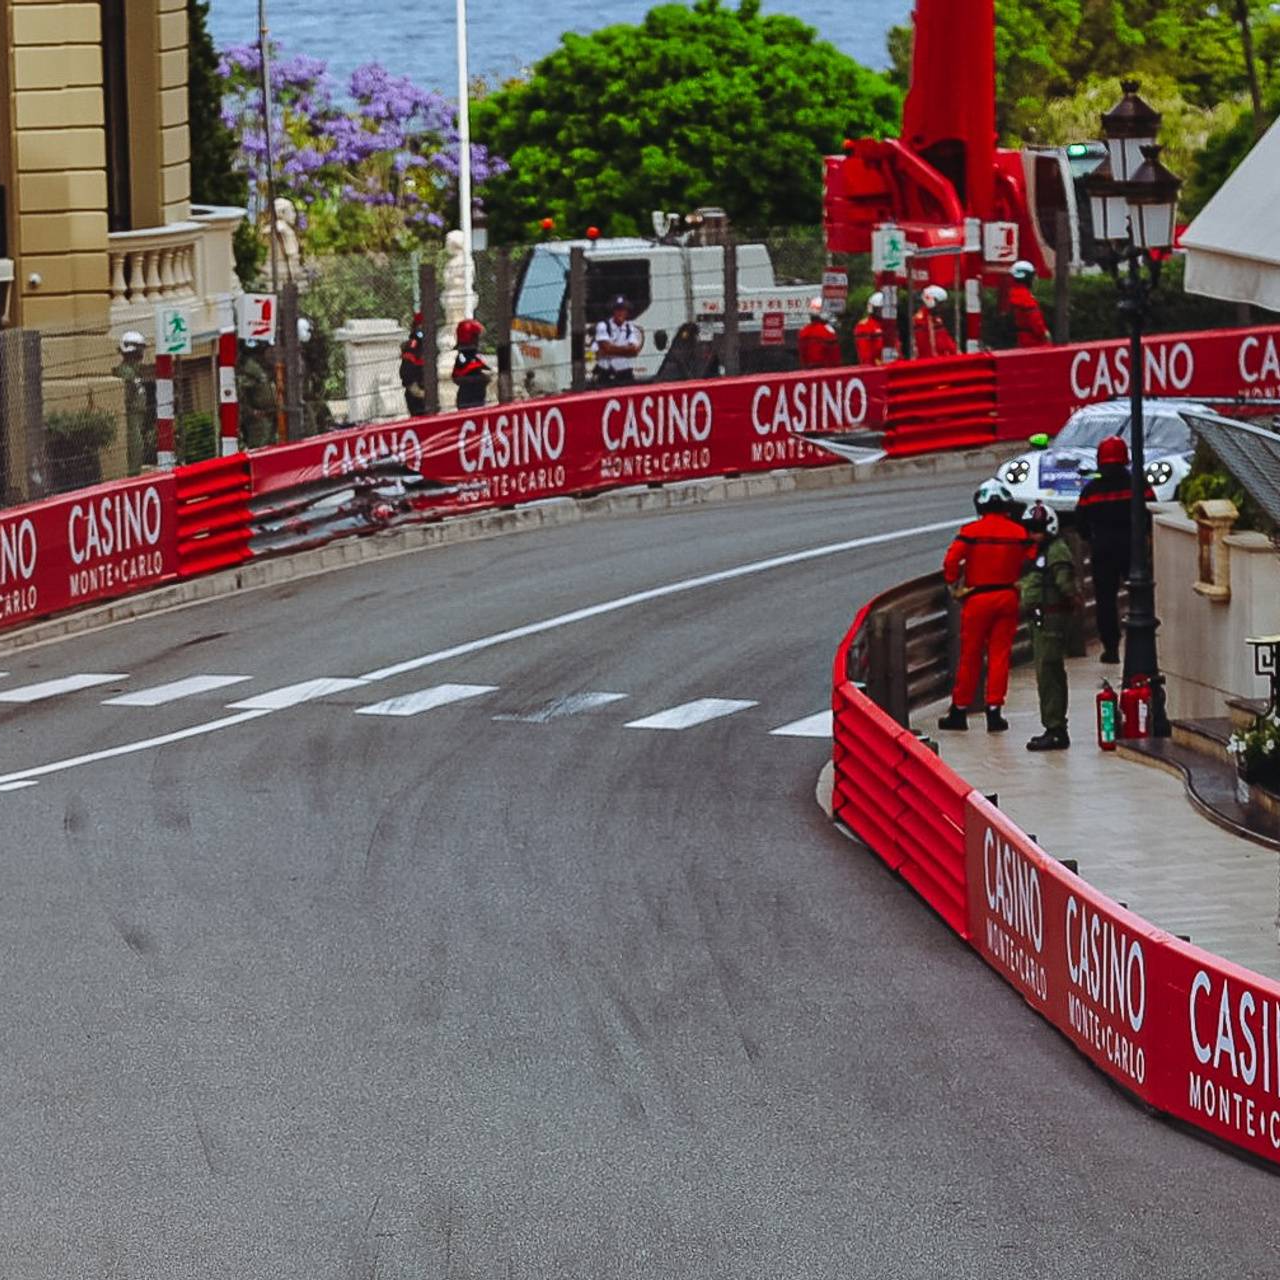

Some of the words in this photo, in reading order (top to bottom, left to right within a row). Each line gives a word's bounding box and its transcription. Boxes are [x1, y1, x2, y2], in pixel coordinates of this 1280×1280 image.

[1071, 341, 1194, 399] CASNO
[602, 391, 712, 452] CASINO
[751, 377, 867, 435] CASINO
[458, 407, 565, 473] CASINO
[69, 486, 161, 564] CASINO
[983, 827, 1042, 954] CASINO
[1066, 896, 1145, 1032] CASINO
